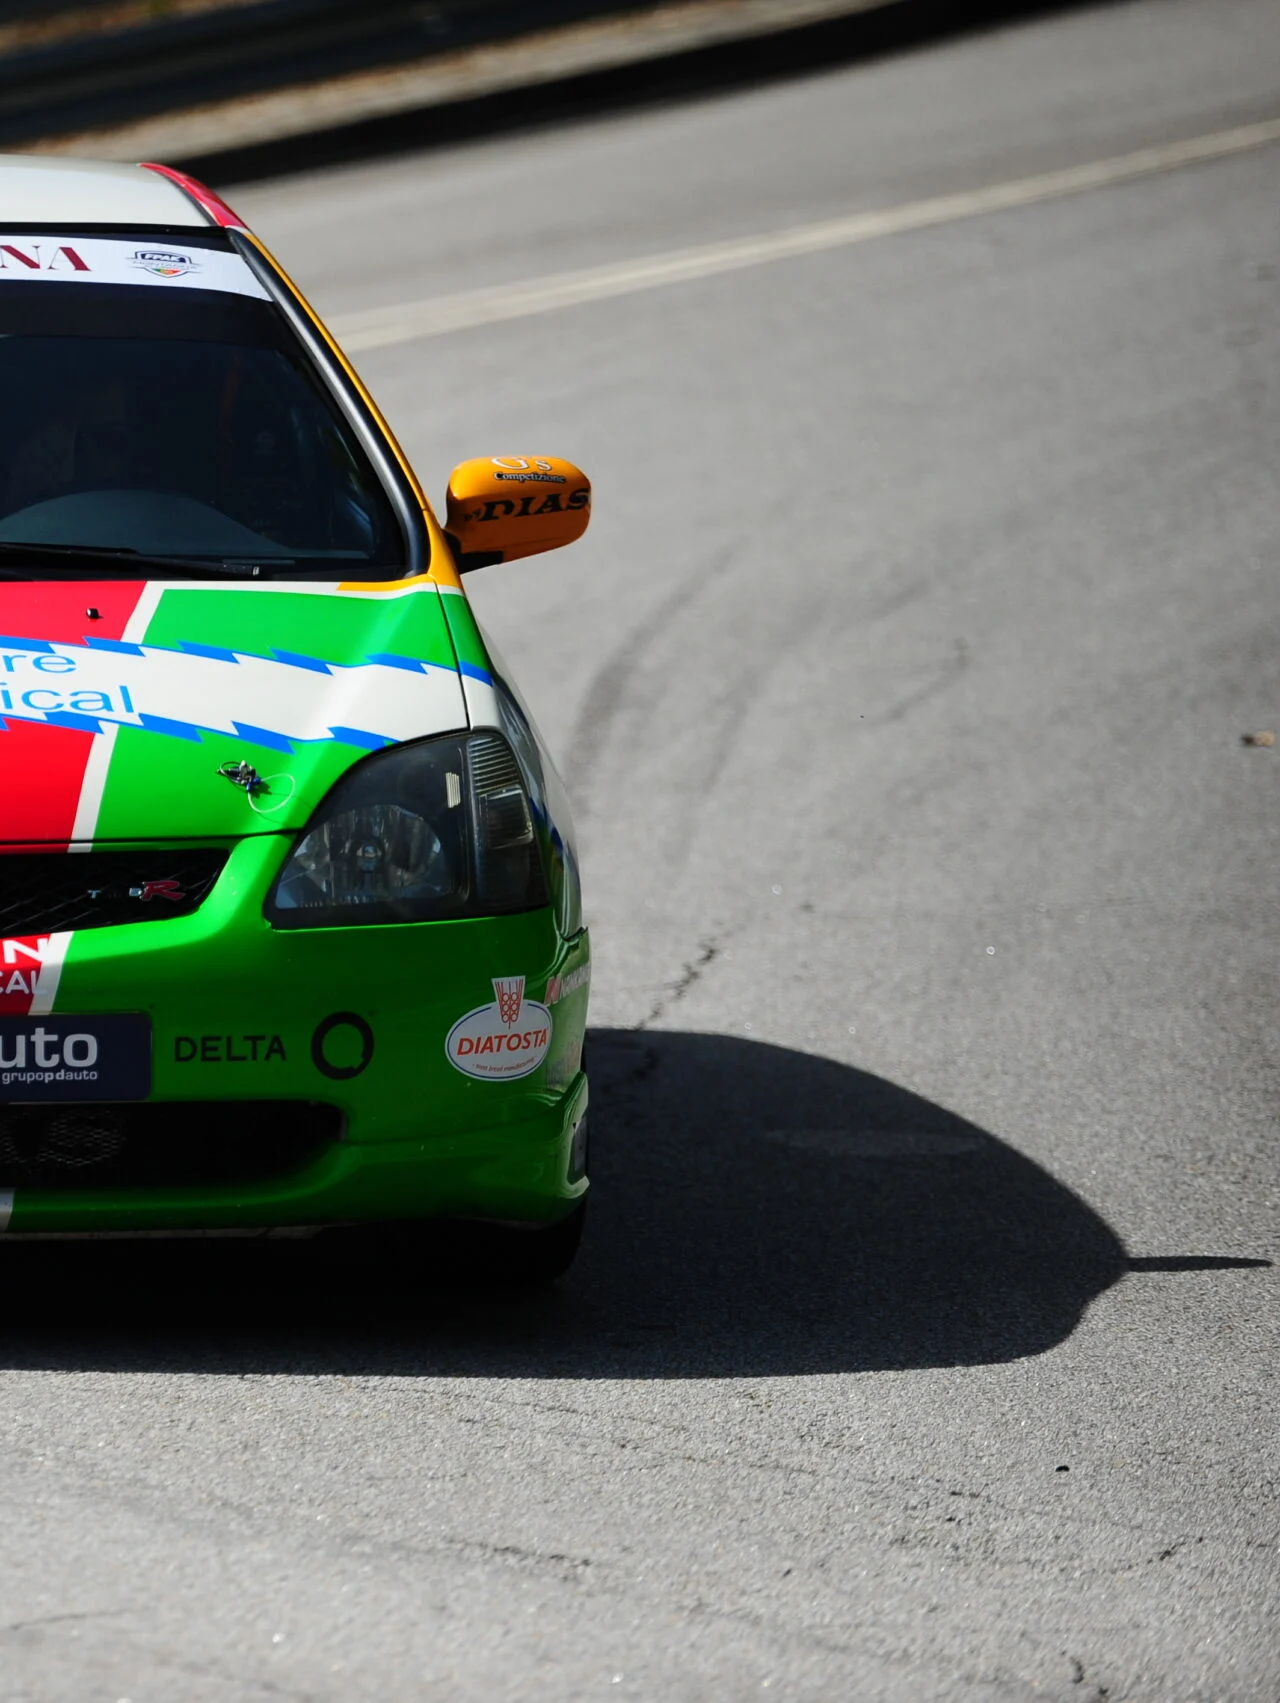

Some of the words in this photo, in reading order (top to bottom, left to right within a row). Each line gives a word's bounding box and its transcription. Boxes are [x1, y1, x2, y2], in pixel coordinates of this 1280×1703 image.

[174, 1035, 287, 1062] DELTA
[456, 1028, 548, 1056] DIATOSTA
[1, 1069, 98, 1085] grupopdauto
